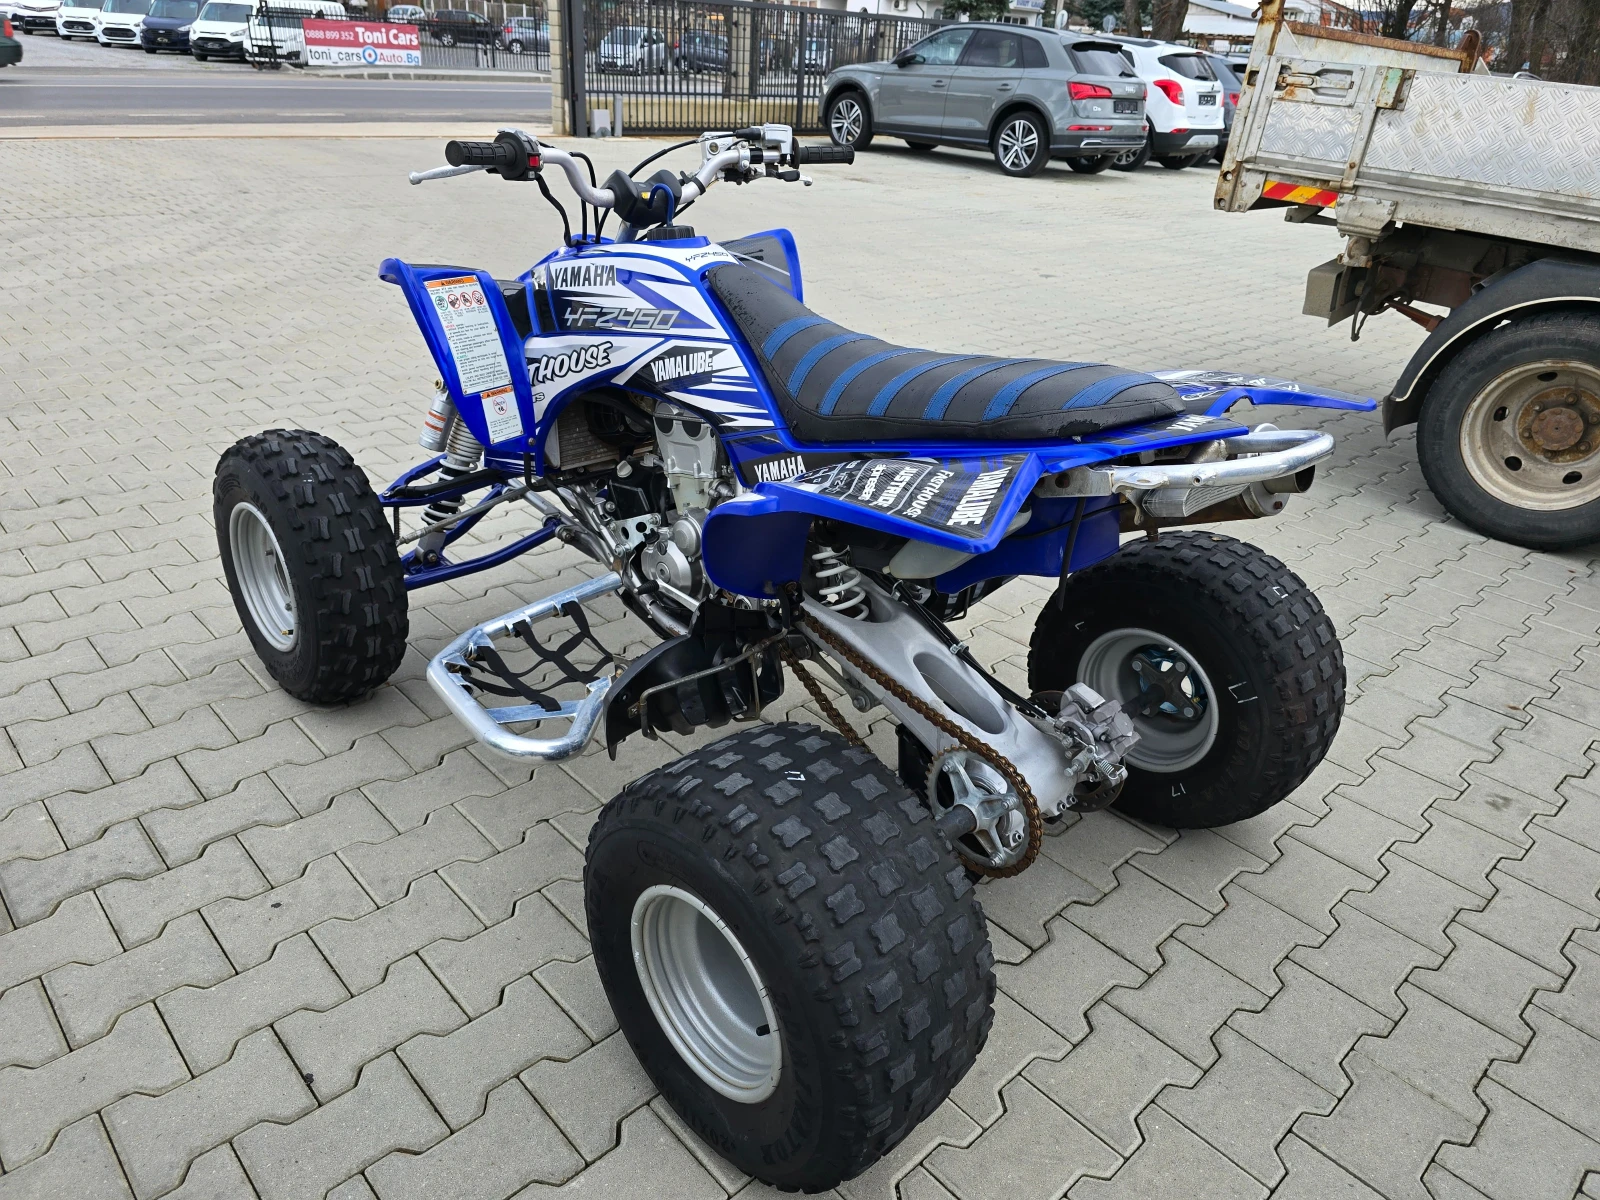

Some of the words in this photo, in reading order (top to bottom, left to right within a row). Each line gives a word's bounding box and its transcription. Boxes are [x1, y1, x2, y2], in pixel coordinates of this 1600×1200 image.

[305, 29, 325, 40] 0888
[325, 30, 340, 41] 899
[340, 31, 355, 41] 352
[355, 26, 387, 45] Toni
[388, 28, 419, 46] Cars
[553, 264, 617, 290] YAMAHA
[564, 307, 681, 331] YFZ450
[527, 341, 614, 387] THOUSE
[650, 350, 714, 383] YAMALUBE
[754, 455, 807, 483] YAMAHA
[946, 466, 1012, 526] YAMALUBE
